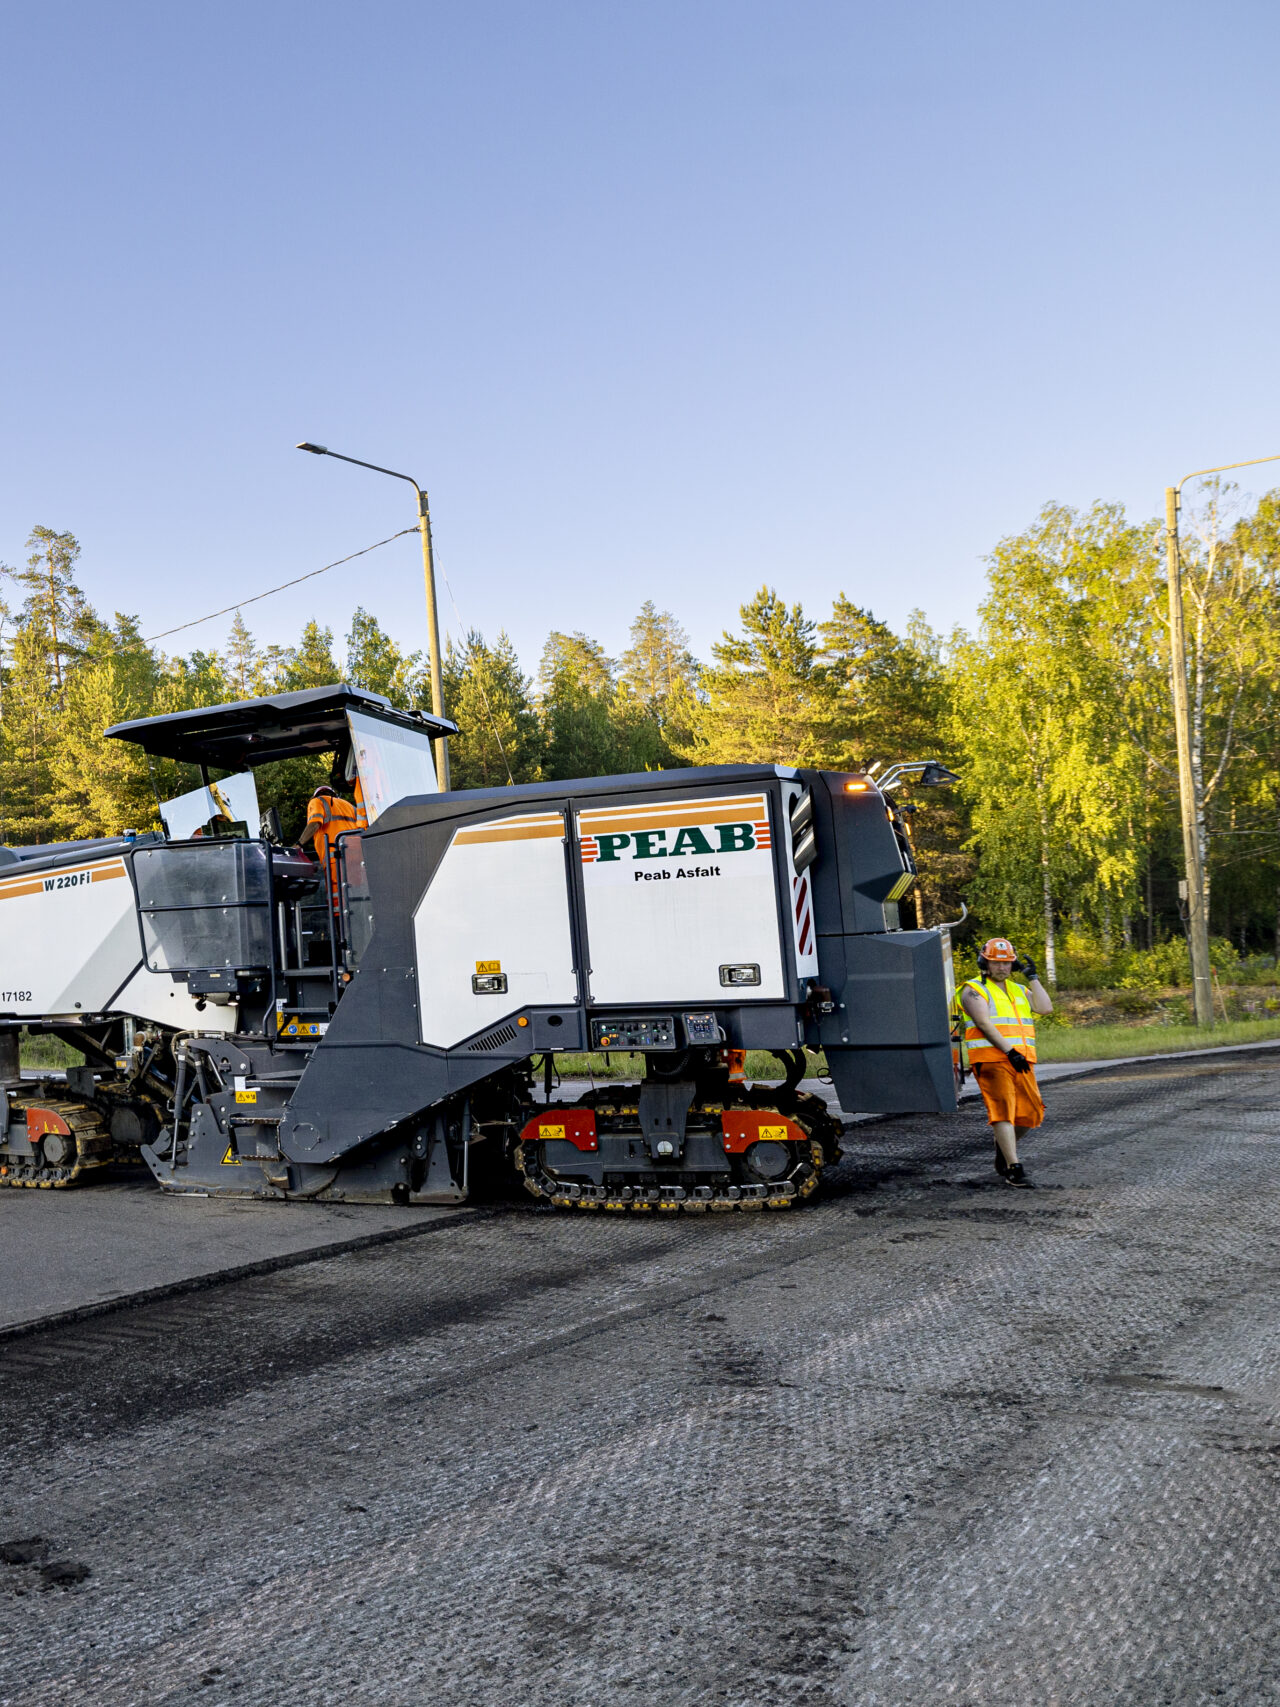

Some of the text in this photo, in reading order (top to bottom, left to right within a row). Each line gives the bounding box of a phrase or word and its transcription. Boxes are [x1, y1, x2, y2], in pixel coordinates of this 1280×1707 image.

[594, 822, 756, 862] PEAB
[44, 871, 91, 892] W 220 Fi
[634, 866, 721, 881] Peab Asfalt
[1, 990, 32, 1002] 17182
